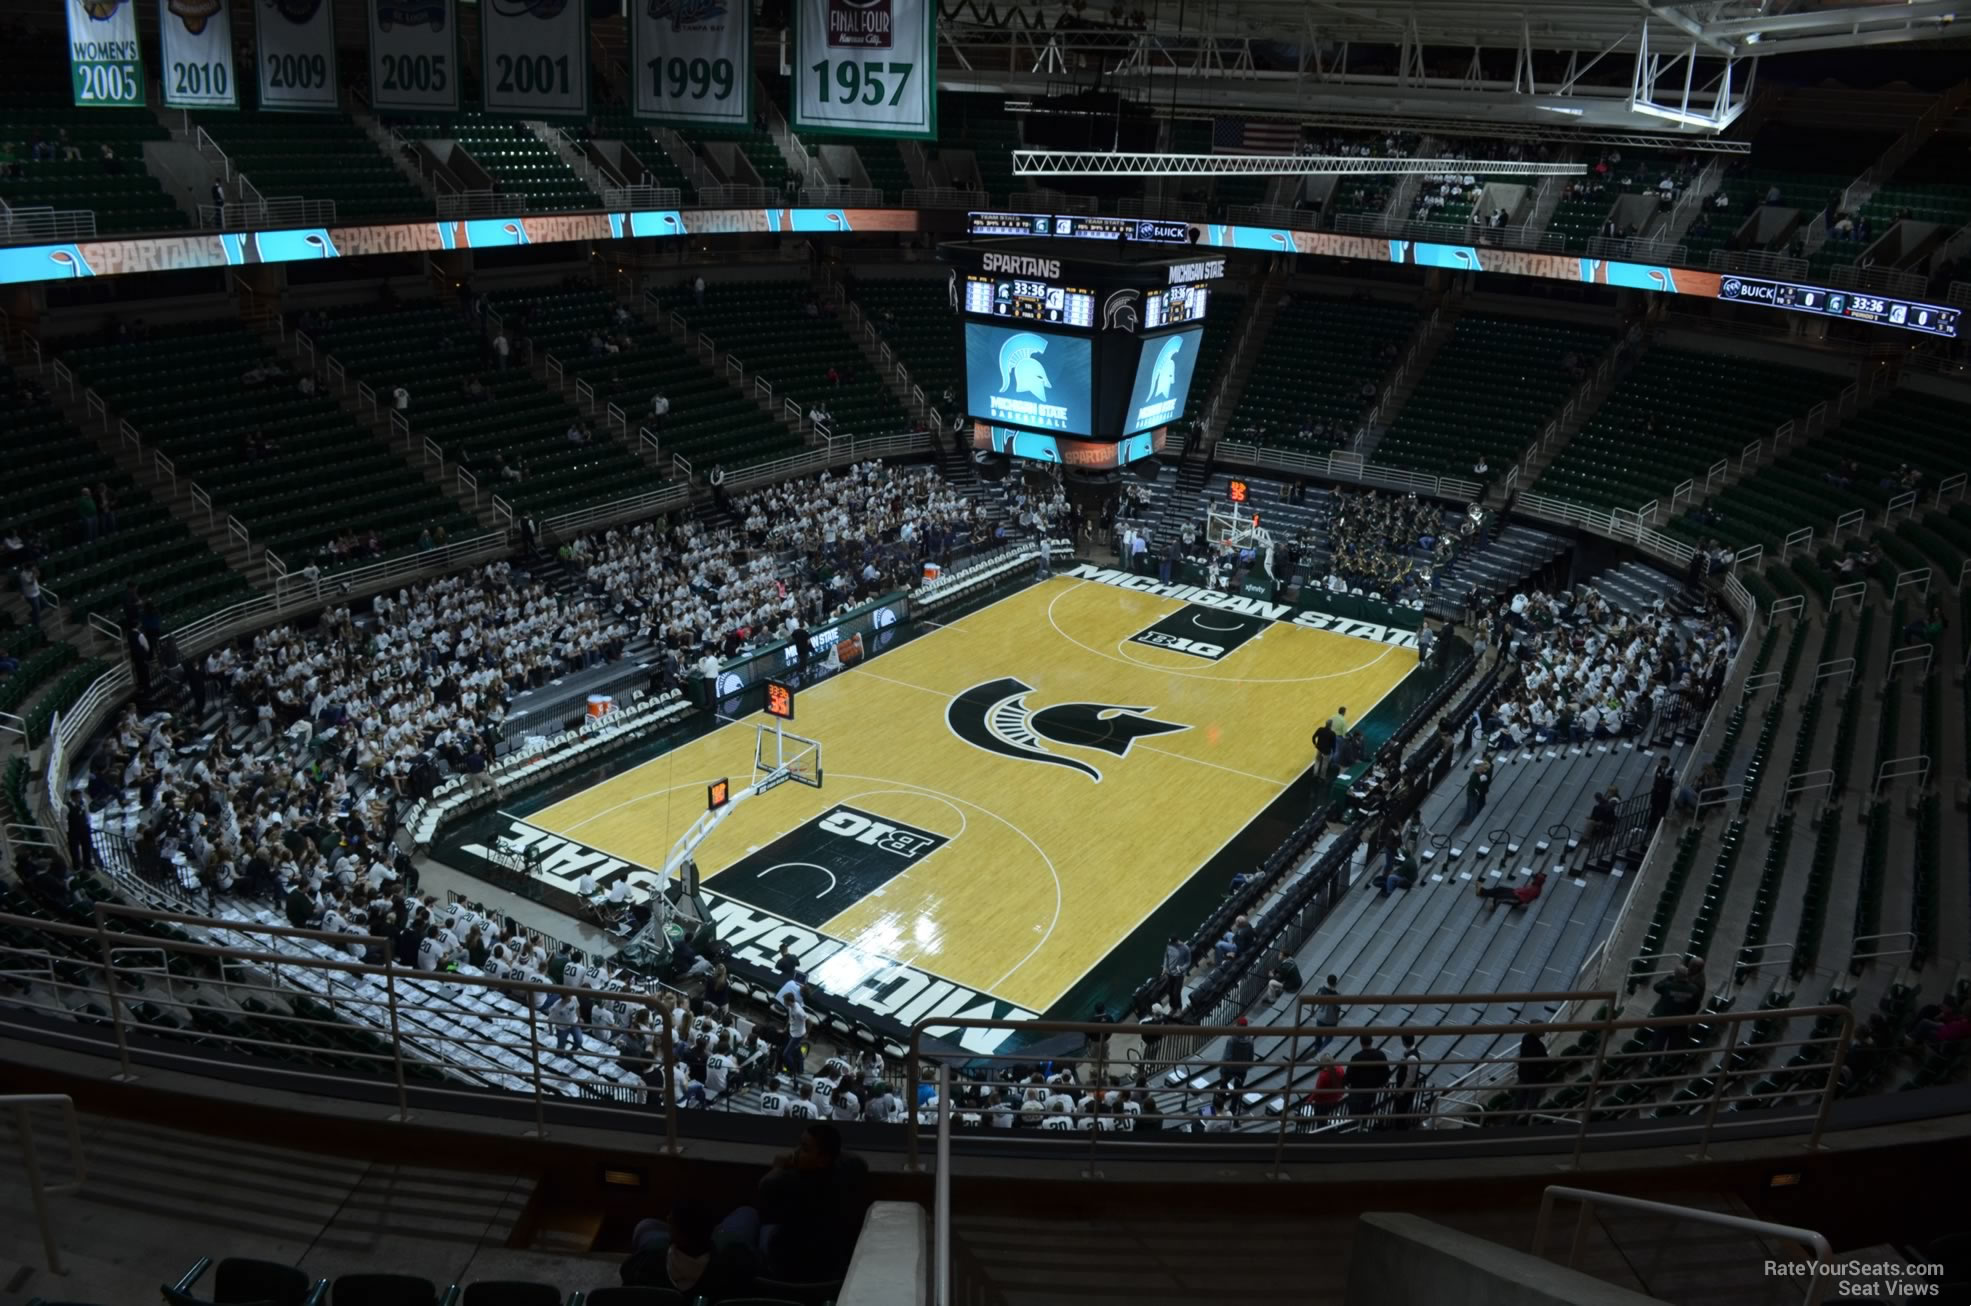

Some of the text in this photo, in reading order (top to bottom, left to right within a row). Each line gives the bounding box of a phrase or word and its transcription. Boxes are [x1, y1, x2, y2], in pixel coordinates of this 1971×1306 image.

[830, 10, 890, 33] FINAL FOUR
[74, 41, 137, 61] WOMEN'S
[173, 62, 227, 95] 2010
[267, 53, 326, 89] 2009
[381, 54, 447, 92] 2005
[496, 54, 569, 94] 2001
[647, 56, 734, 100] 1999
[78, 64, 137, 101] 2005
[812, 59, 914, 106] 1957
[525, 215, 611, 242] SPARTANS
[682, 210, 768, 233] SPARTANS
[332, 224, 442, 256] SPARTANS
[1154, 226, 1184, 238] BUICK
[1296, 231, 1390, 259] SPARTANS
[85, 236, 226, 275] SPARTANS
[983, 252, 1060, 279] SPARTANS
[1168, 259, 1226, 285] MICHIGAN STATE
[1477, 248, 1580, 280] SPARTANS
[1014, 281, 1045, 297] 33:36
[1740, 284, 1774, 300] BUICK
[1804, 292, 1815, 307] 0
[1852, 296, 1884, 313] 33:36
[999, 303, 1007, 315] 0
[1050, 309, 1058, 321] 0
[1918, 311, 1928, 326] 0
[991, 408, 1068, 429] BASKETBALL
[1038, 405, 1068, 420] STATE
[1064, 563, 1292, 621] MICHIGAN
[818, 627, 839, 648] STATE
[447, 904, 458, 915] 20
[463, 912, 474, 922] 20
[479, 919, 490, 931] 20
[420, 940, 432, 954] 20
[511, 940, 522, 950] 20
[485, 960, 497, 974] 20
[565, 966, 577, 977] 20
[586, 966, 599, 979] 20
[511, 969, 525, 982] 20
[613, 1001, 627, 1015] 20
[708, 1057, 723, 1070] 20
[815, 1081, 833, 1097] 20
[763, 1095, 780, 1110] 20
[792, 1105, 808, 1120] 20
[1114, 1117, 1131, 1129] 20
